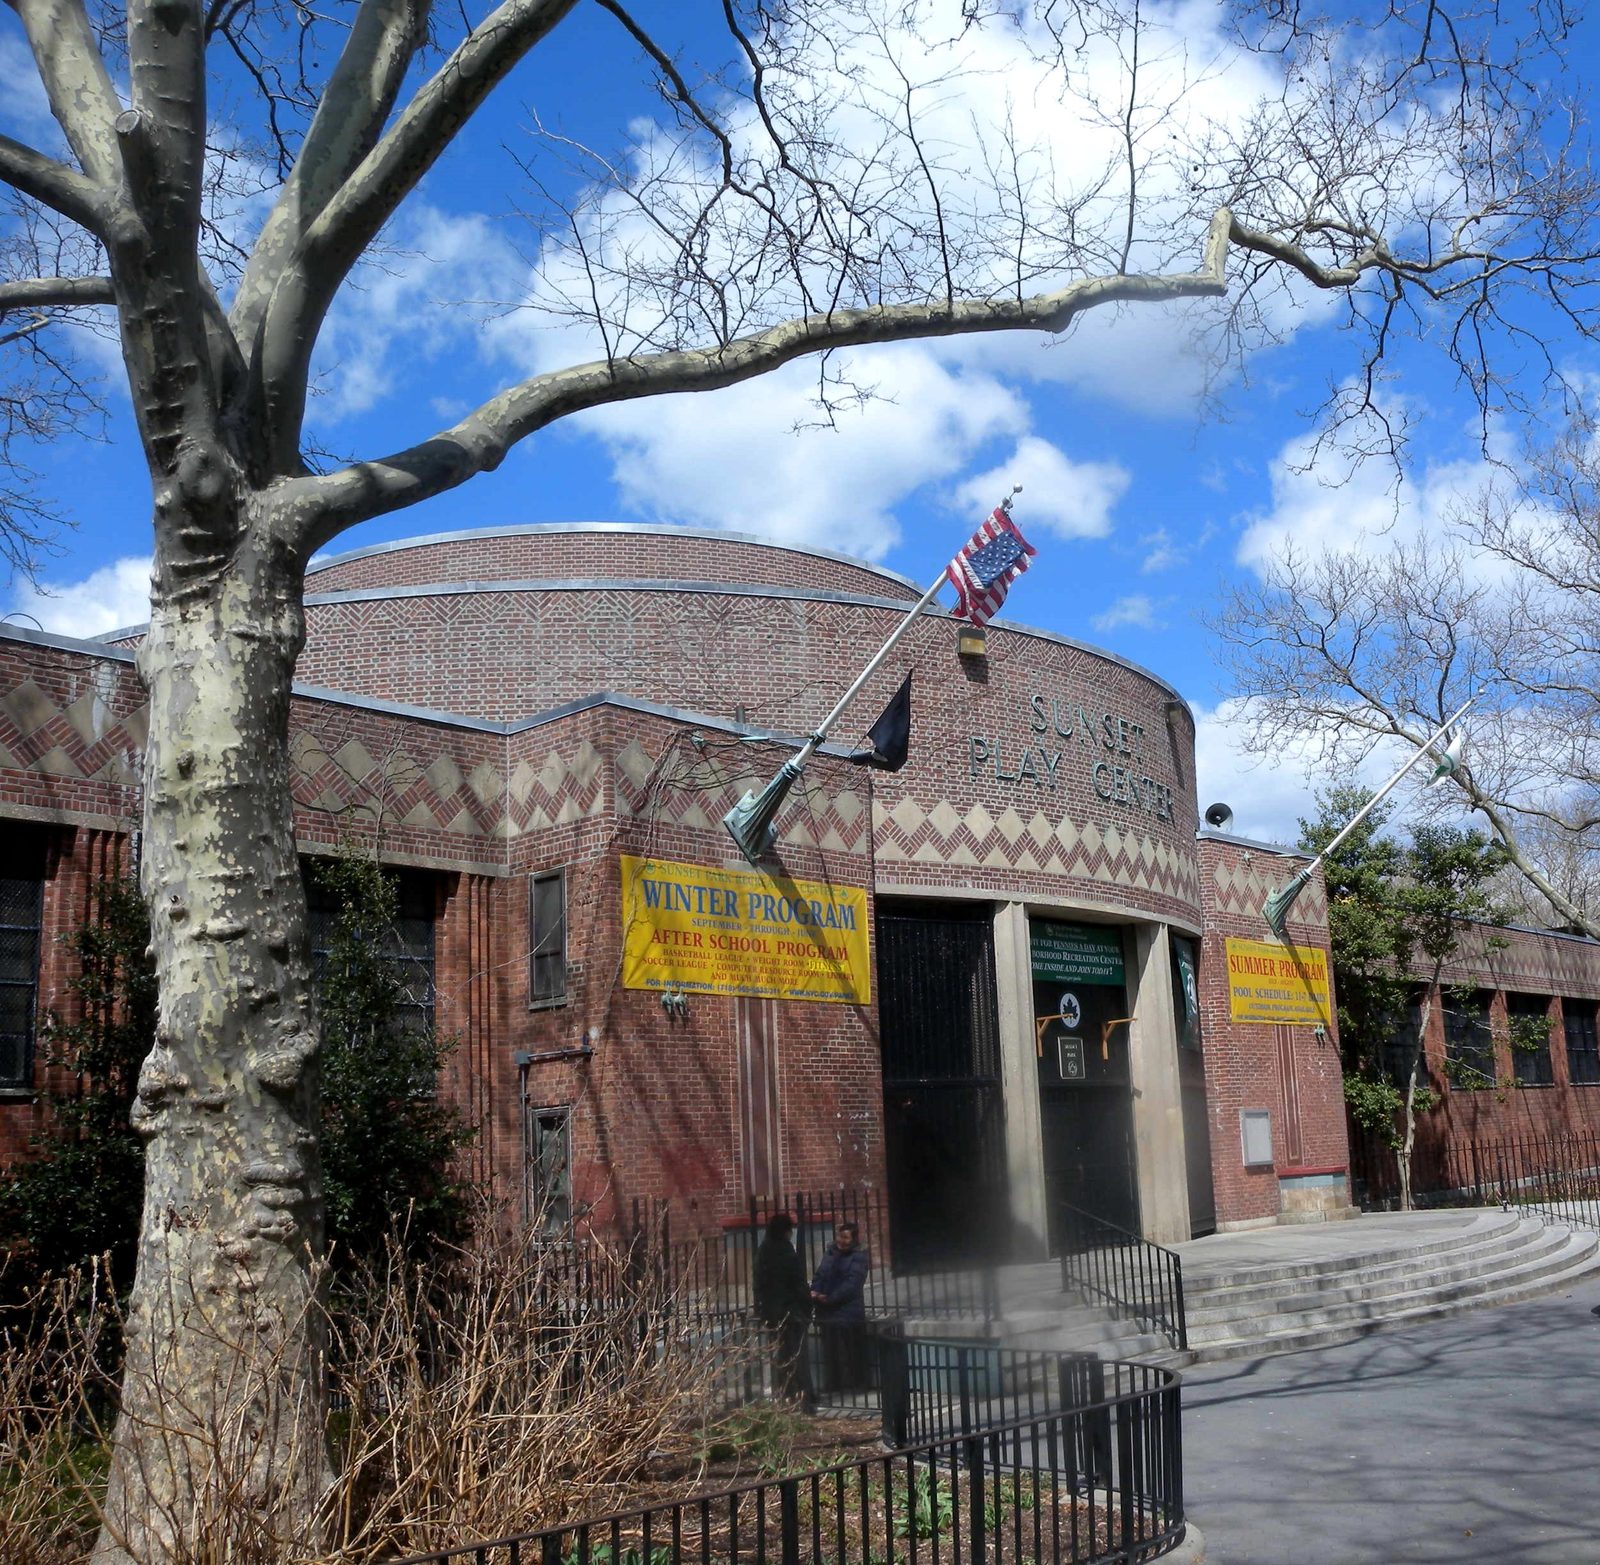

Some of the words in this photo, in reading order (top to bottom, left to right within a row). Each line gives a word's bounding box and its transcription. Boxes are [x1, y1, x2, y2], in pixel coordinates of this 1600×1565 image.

[1030, 695, 1144, 762] SUNSET
[968, 736, 1062, 788] PLAY
[1092, 761, 1175, 825] CENTER
[660, 863, 701, 879] SUNSET
[641, 879, 740, 919] WINTER
[747, 892, 857, 931] PROGRAM
[691, 917, 742, 931] SEPTEMBER
[751, 923, 790, 936] THROUGH
[651, 929, 704, 948] AFTER
[709, 934, 771, 954] SCHOOL
[776, 941, 848, 961] PROGRAM
[663, 948, 713, 960] BASKETBALL
[715, 952, 744, 962] LEAGUE
[752, 956, 781, 966] WEIGHT
[783, 958, 805, 967] ROOM
[1062, 952, 1100, 963] RECREATION
[1230, 954, 1276, 976] SUMMER
[1279, 960, 1325, 980] PROGRAM
[642, 957, 674, 967] SOCCER
[677, 960, 708, 969] LEAGUE
[716, 962, 758, 973] COMPUTER
[759, 966, 796, 976] RESOURCE
[798, 969, 821, 978] ROOM
[1044, 963, 1066, 972] INSIDE
[1065, 965, 1078, 973] AND
[1077, 966, 1092, 974] JOIN
[646, 978, 661, 987] FOR
[711, 971, 727, 981] AND
[755, 975, 777, 984] MUCH
[778, 977, 799, 986] MORE
[1234, 987, 1252, 998] POOL
